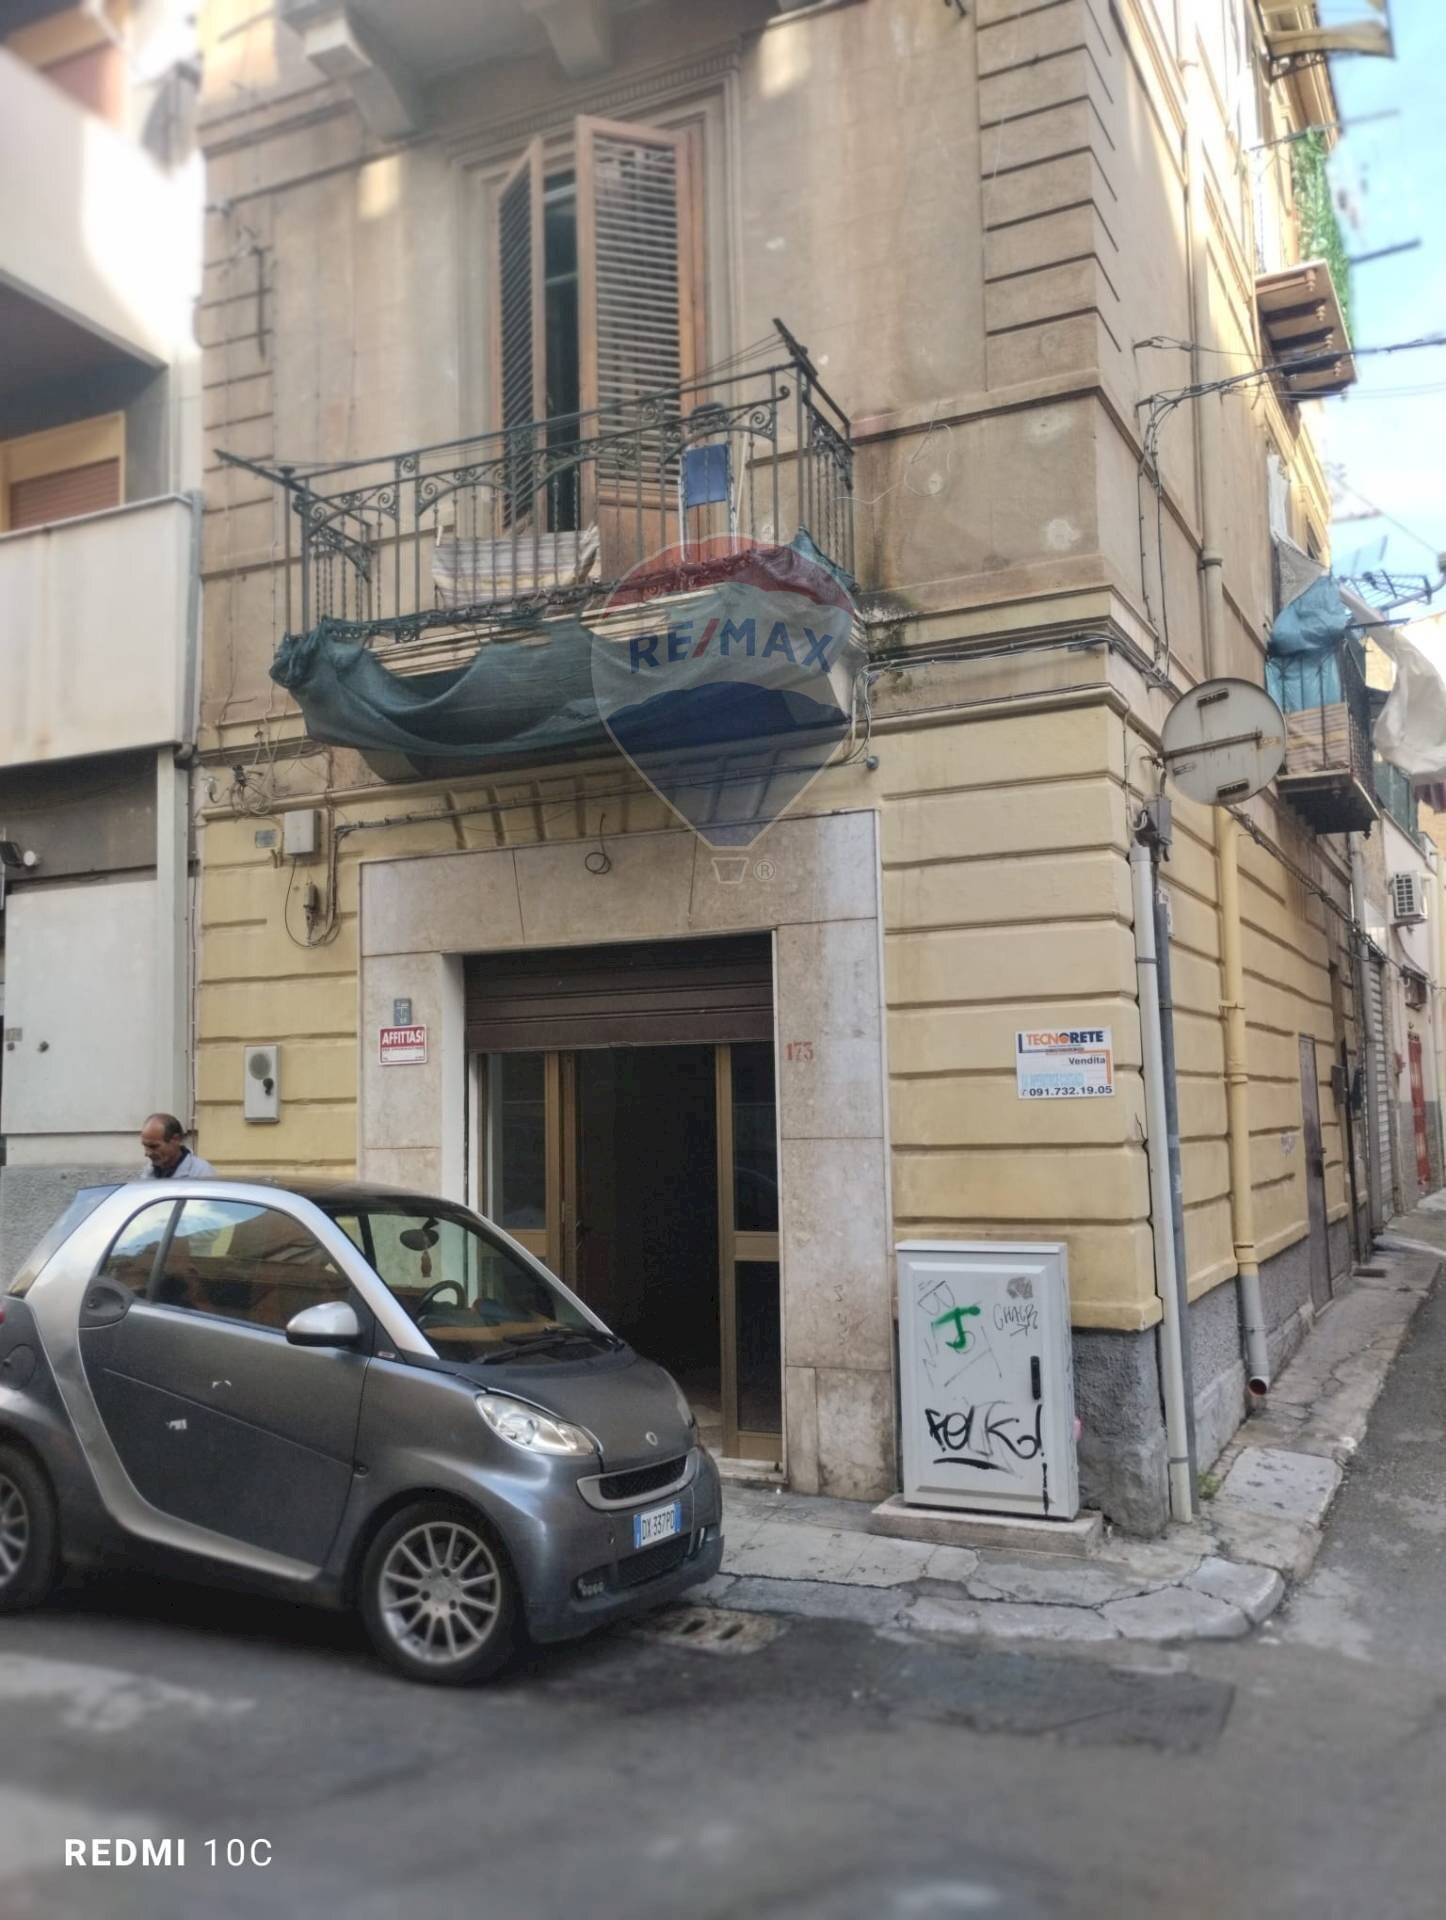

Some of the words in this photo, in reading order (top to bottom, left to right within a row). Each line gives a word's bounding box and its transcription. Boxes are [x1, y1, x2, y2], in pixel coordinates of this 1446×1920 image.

[381, 1030, 425, 1045] AFFITTASI
[1026, 1031, 1104, 1046] TECNORETE
[1068, 1056, 1106, 1065] Vendita
[1029, 1085, 1113, 1097] 091.732.19.05
